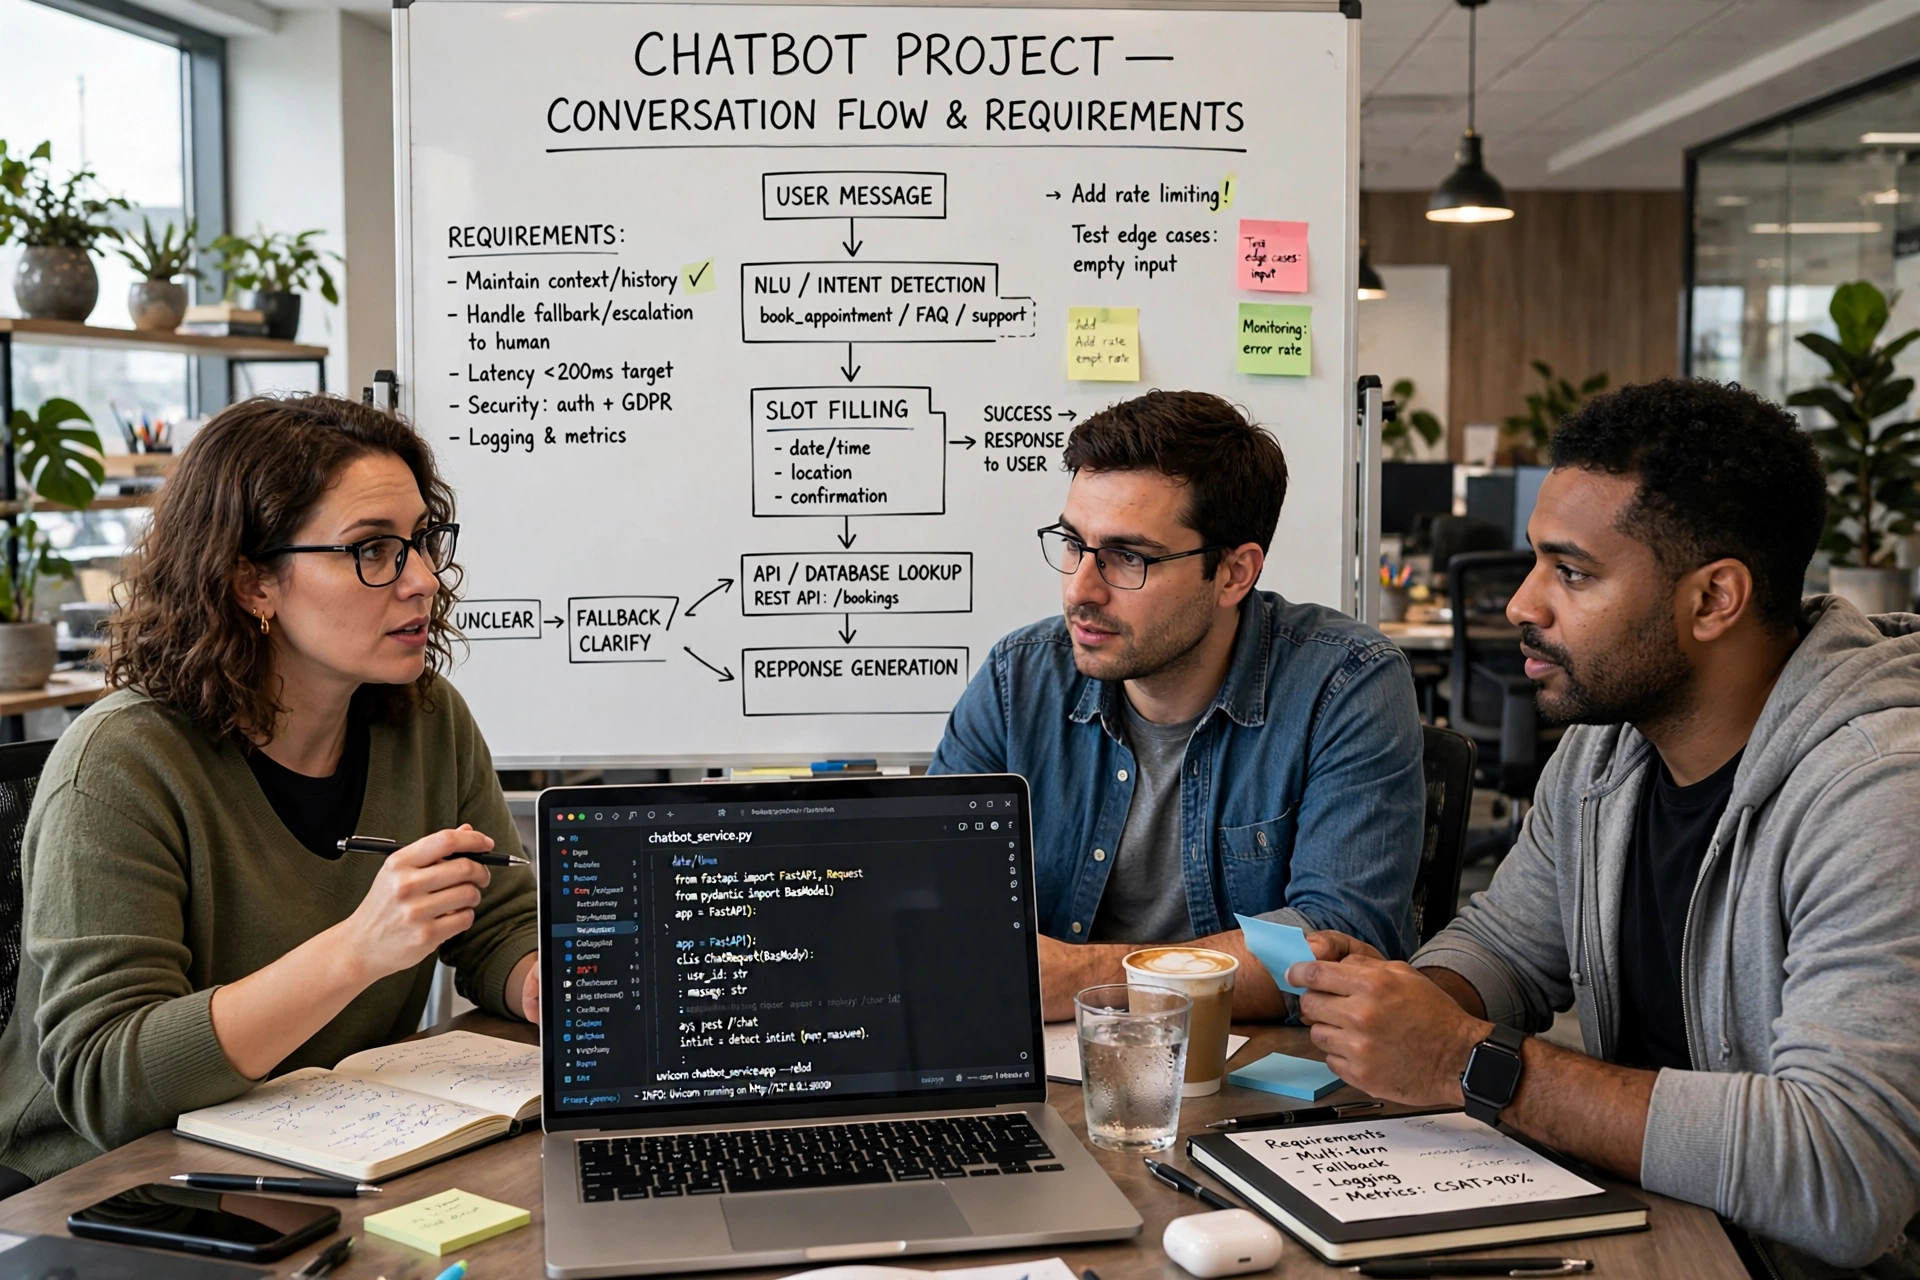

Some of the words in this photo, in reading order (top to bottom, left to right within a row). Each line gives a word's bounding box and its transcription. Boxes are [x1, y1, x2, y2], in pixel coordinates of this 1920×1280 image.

[634, 31, 868, 76] CHATBOT
[896, 32, 1115, 76] PROJECT
[547, 97, 816, 133] CONVERSATION
[838, 98, 929, 131] FLOW
[946, 99, 968, 130] &
[986, 97, 1245, 132] REQUIREMENTS
[776, 185, 830, 206] USER
[839, 185, 933, 206] MESSAGE
[1071, 183, 1106, 203] Add
[1115, 185, 1150, 203] rate
[1160, 181, 1230, 211] limiting!
[448, 224, 625, 249] REQUIREMENTS:
[1072, 223, 1110, 244] Test
[1118, 223, 1157, 250] edge
[1166, 228, 1218, 244] cases:
[1073, 254, 1125, 280] empty
[1134, 254, 1178, 280] input
[465, 270, 540, 290] Maintain
[548, 266, 678, 295] context/history
[754, 275, 791, 294] NLU
[818, 275, 882, 294] INTENT
[891, 275, 986, 294] DETECTION
[467, 303, 526, 324] Handle
[760, 306, 893, 328] book_appointment
[916, 305, 949, 325] FAQ
[972, 306, 1027, 327] support
[1243, 319, 1308, 341] Monitoring:
[468, 332, 487, 351] to
[496, 331, 550, 350] human
[1243, 344, 1273, 356] error
[1278, 342, 1303, 356] rate
[468, 363, 535, 389] Latency
[544, 361, 613, 381] <200ms
[621, 360, 674, 386] target
[468, 394, 548, 420] Security:
[556, 393, 595, 412] auth
[622, 392, 673, 412] GDPR
[766, 400, 818, 420] SLOT
[829, 399, 909, 420] FILLING
[984, 405, 1053, 422] SUCCESS
[469, 427, 534, 453] Logging
[544, 426, 557, 445] &
[565, 426, 627, 444] metrics
[789, 436, 871, 458] date/time
[984, 431, 1064, 449] RESPONSE
[791, 462, 852, 481] location
[984, 456, 999, 472] to
[1006, 456, 1048, 472] USER
[790, 486, 887, 505] confirmation
[753, 565, 781, 582] API
[805, 564, 890, 582] DATABASE
[899, 564, 962, 581] LOOKUP
[754, 590, 791, 606] REST
[796, 590, 827, 605] API:
[833, 588, 899, 610] /bookings
[456, 610, 535, 630] UNCLEAR
[577, 608, 661, 627] FALLBACK
[579, 633, 652, 653] CLARIFY
[755, 659, 843, 678] REPPONSE
[851, 658, 958, 677] GENERATION
[648, 830, 752, 844] chatbot_service.py
[675, 874, 698, 885] from
[701, 871, 738, 886] fastapi
[743, 871, 775, 885] import
[826, 868, 863, 882] Request
[675, 890, 698, 901] from
[701, 888, 744, 903] pydantic
[675, 909, 693, 921] app
[676, 938, 695, 950] app
[732, 969, 748, 979] str
[731, 984, 748, 995] str
[1264, 1129, 1386, 1150] Requirements
[1296, 1145, 1388, 1161] Multi-turn
[1312, 1158, 1390, 1174] Fallback
[1328, 1173, 1402, 1188] Logging
[1346, 1185, 1426, 1202] Metrics:
